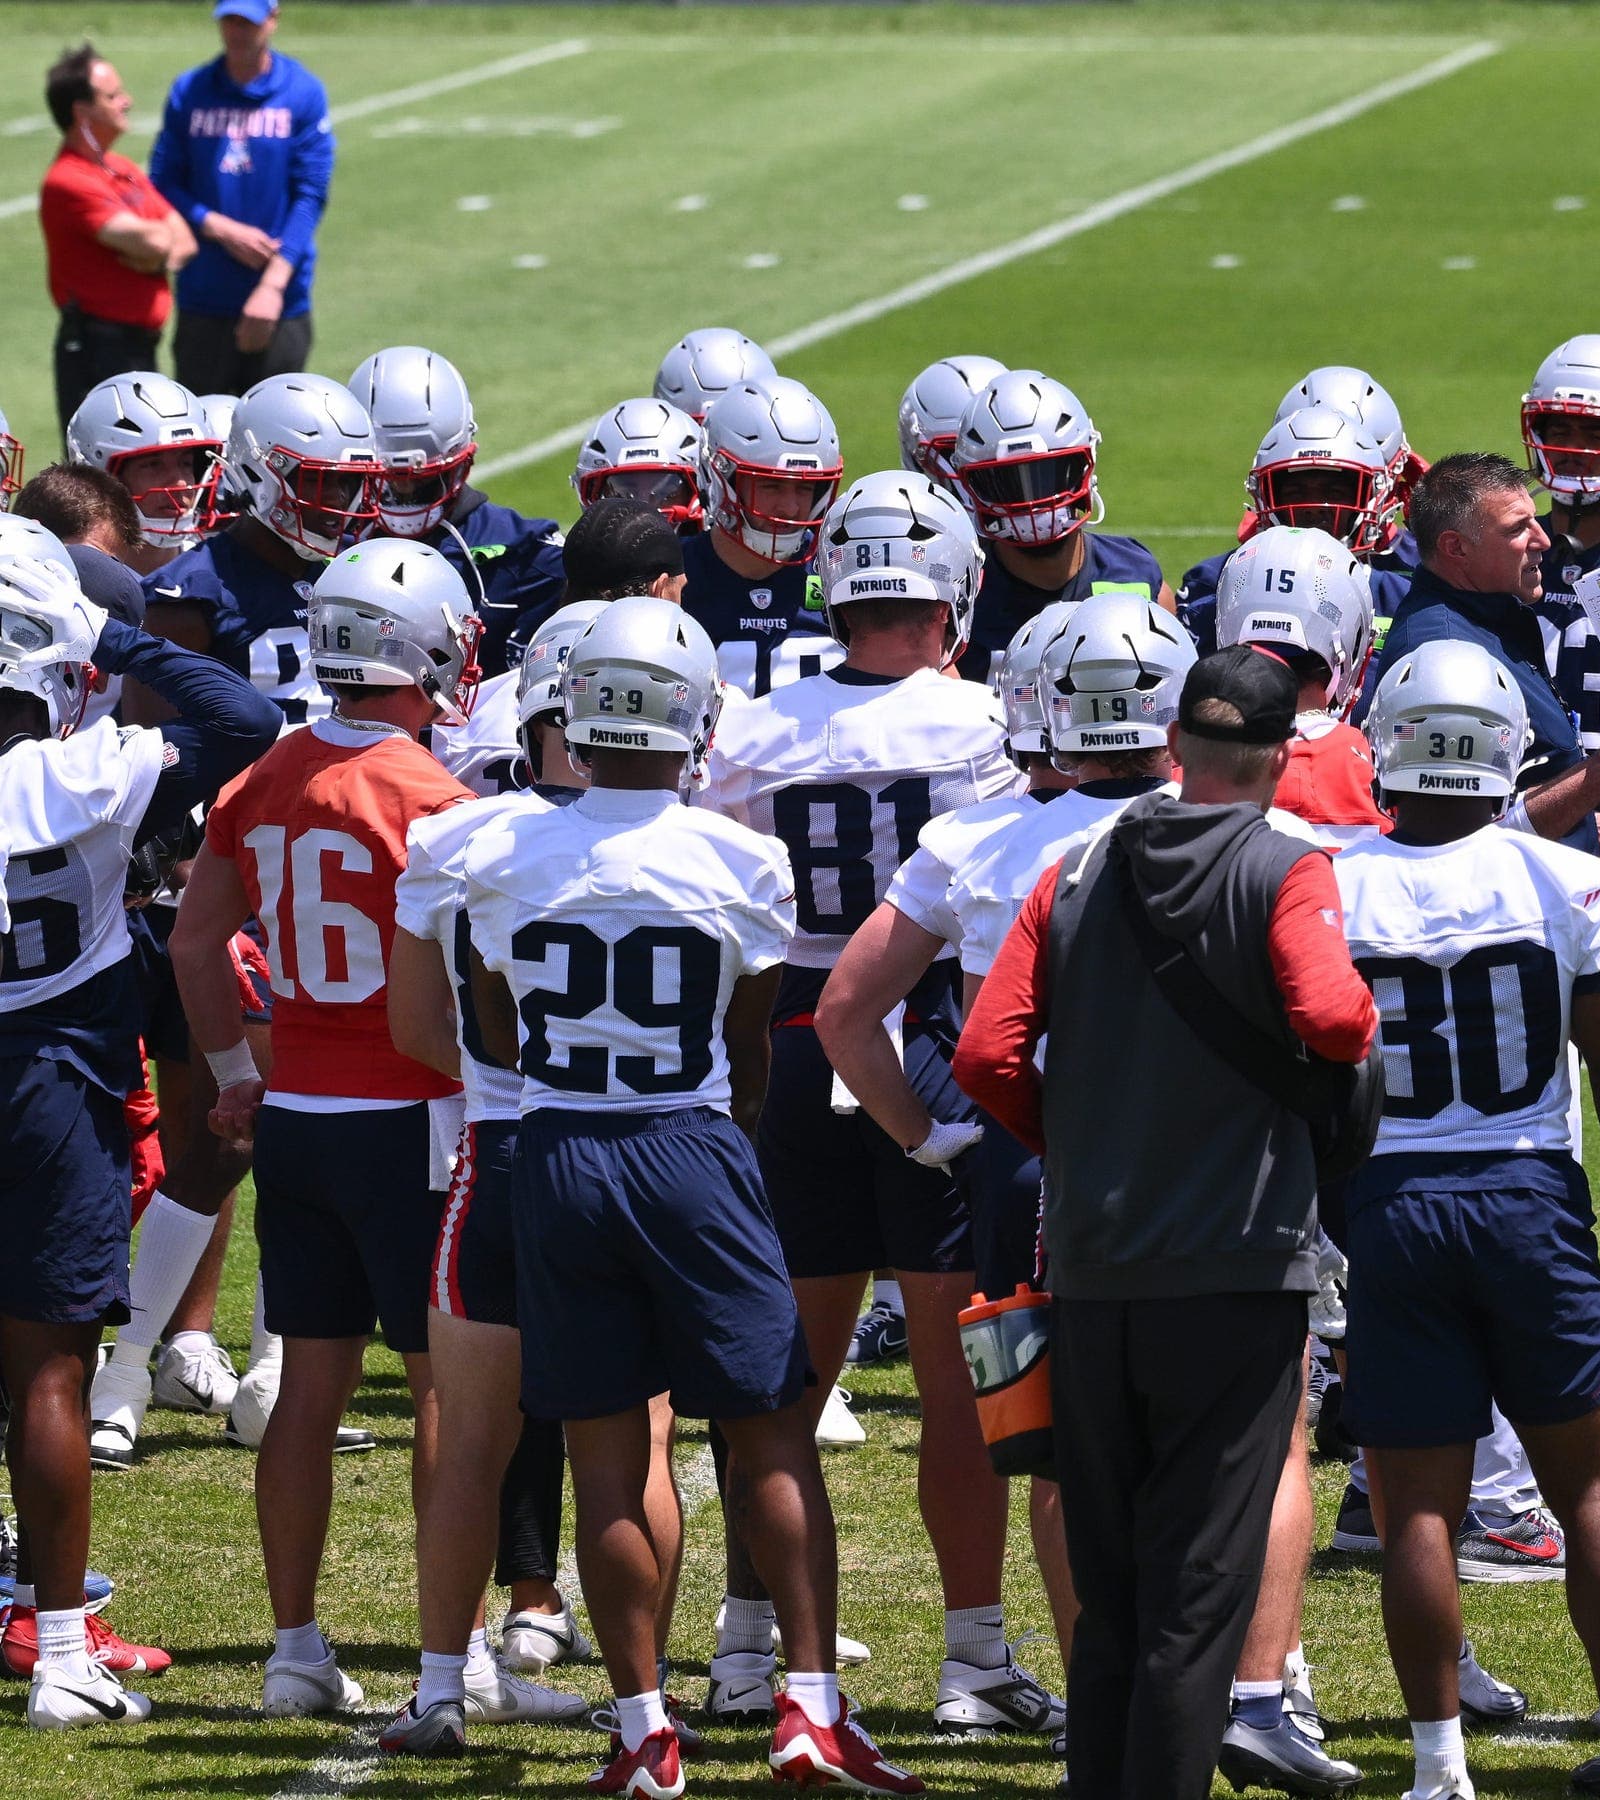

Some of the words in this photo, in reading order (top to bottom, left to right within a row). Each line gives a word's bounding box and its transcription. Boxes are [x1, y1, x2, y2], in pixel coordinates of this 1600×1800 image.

[856, 542, 890, 568] 81
[850, 578, 907, 595] PATRIOTS
[1265, 568, 1296, 594] 15
[321, 624, 350, 650] 16
[740, 617, 788, 631] PATRIOTS
[1252, 619, 1292, 633] PATRIOTS
[315, 663, 365, 683] PATRIOTS
[598, 686, 643, 715] 29
[1090, 697, 1128, 723] 19
[589, 727, 649, 747] PATRIOTS
[1080, 731, 1140, 747] PATRIOTS
[1428, 732, 1474, 760] 30
[1418, 773, 1481, 791] PATRIOTS
[774, 777, 931, 934] 81
[243, 824, 387, 1003] 16
[511, 920, 722, 1095] 29
[1352, 940, 1562, 1120] 30
[1004, 1694, 1032, 1715] ALPHA
